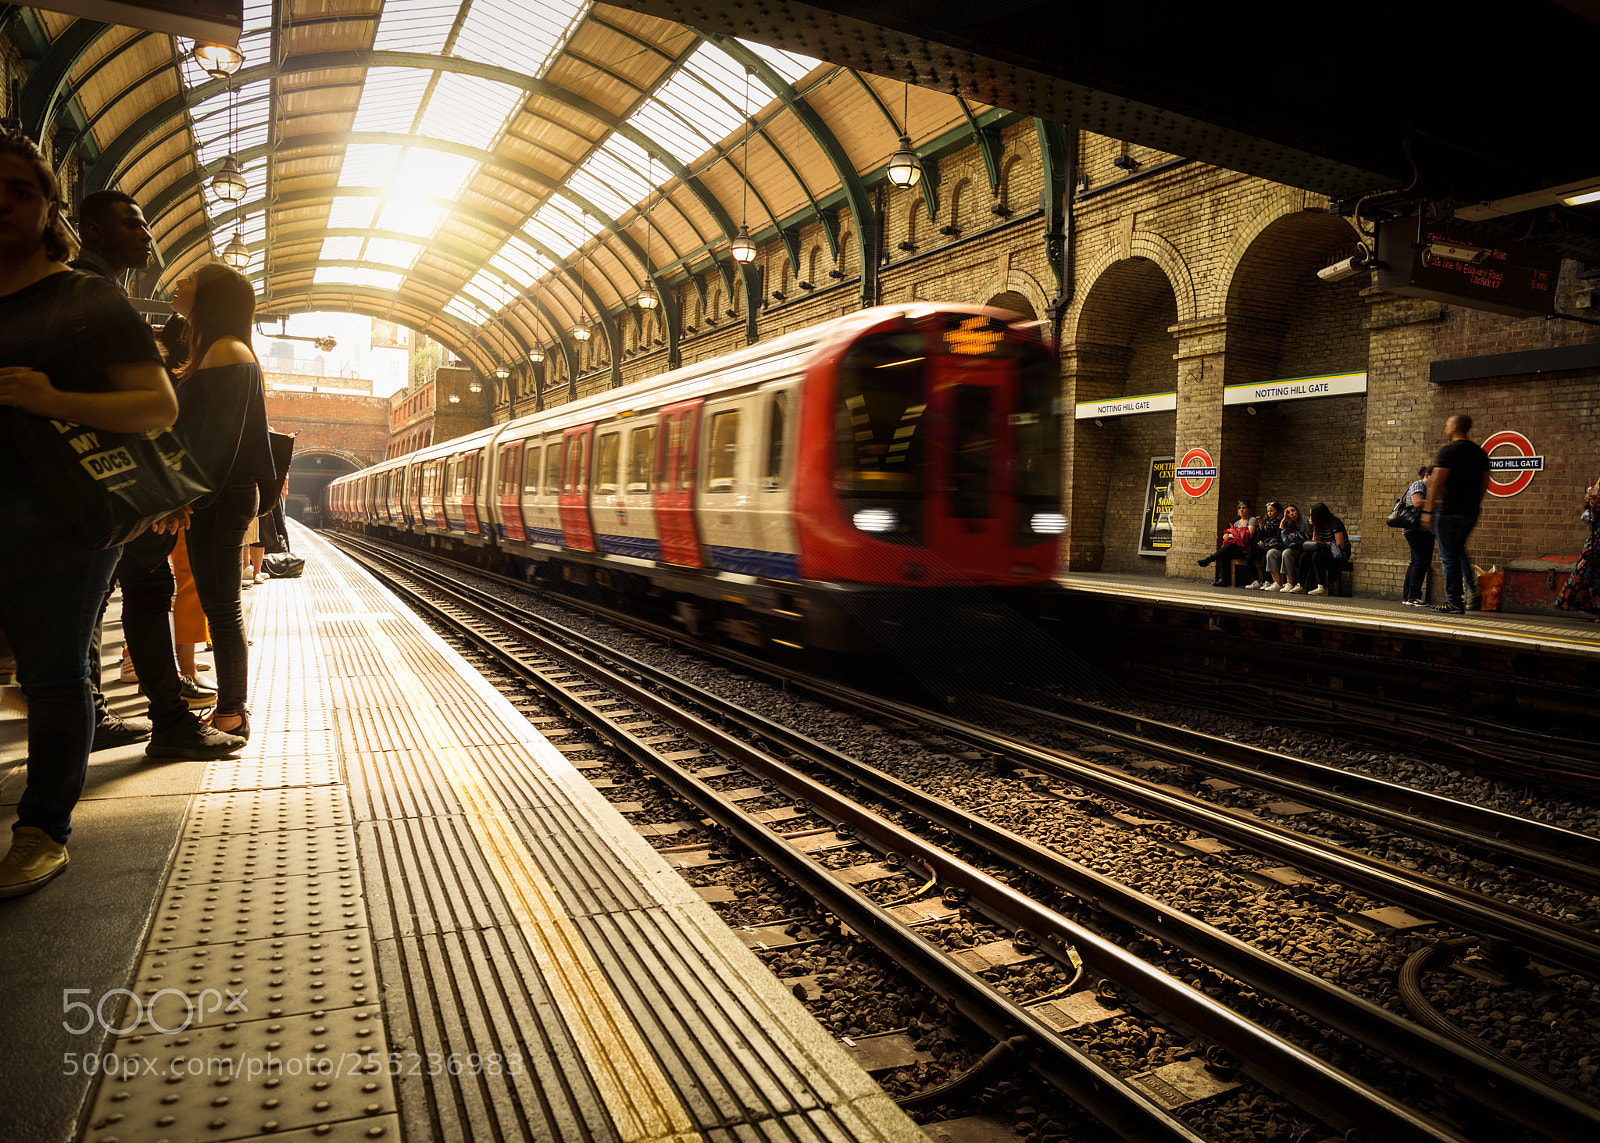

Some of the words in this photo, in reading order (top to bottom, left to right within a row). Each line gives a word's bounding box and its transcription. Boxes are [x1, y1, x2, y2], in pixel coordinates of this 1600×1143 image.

[1455, 261, 1463, 272] to
[1488, 269, 1503, 281] Road
[1255, 388, 1289, 398] NOTTING
[1290, 385, 1306, 395] HILL
[1308, 383, 1329, 393] GATE
[1097, 404, 1122, 414] NOTTING
[1122, 403, 1134, 411] HILL
[1135, 401, 1150, 410] GATE
[68, 432, 102, 455] MY
[87, 451, 131, 475] DOCS
[1153, 462, 1176, 471] SOUTH
[1159, 470, 1175, 479] CENT
